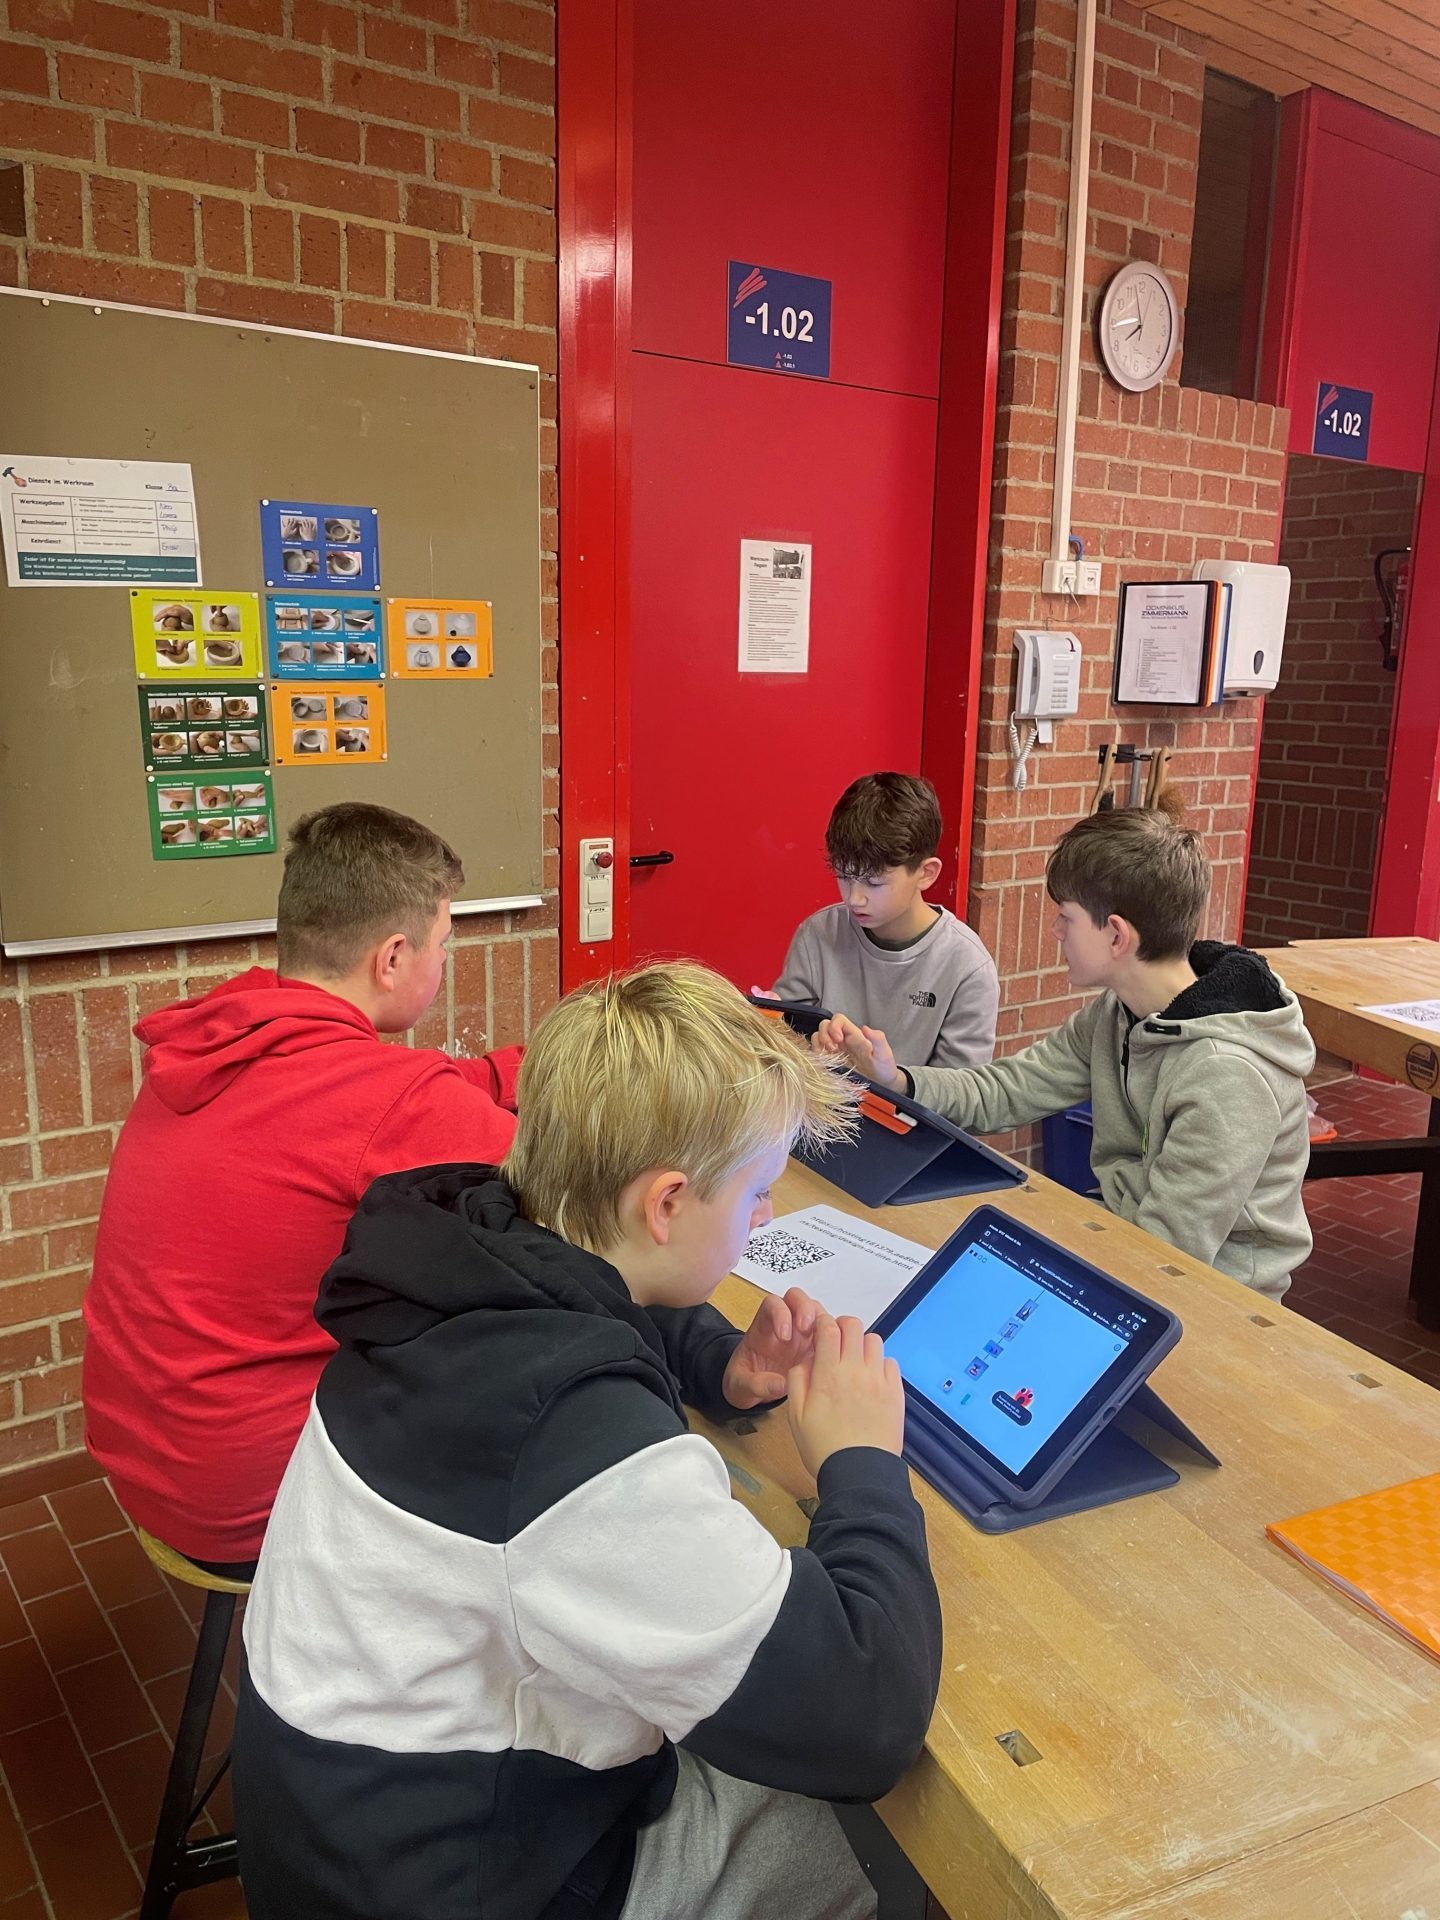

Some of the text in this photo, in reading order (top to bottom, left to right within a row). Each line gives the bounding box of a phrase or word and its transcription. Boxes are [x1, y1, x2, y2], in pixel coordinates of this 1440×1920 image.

[1127, 286, 1134, 299] 11
[1138, 280, 1147, 294] 12
[1116, 298, 1125, 311] 10
[1158, 304, 1166, 318] 2
[745, 302, 814, 343] -1.02
[1160, 325, 1168, 338] 3
[1113, 339, 1120, 353] 8
[1121, 354, 1128, 368] 7
[1133, 359, 1140, 374] 6
[1145, 356, 1153, 369] 5
[1324, 409, 1362, 437] -1.02
[908, 993, 929, 1002] NORTH
[911, 999, 928, 1007] FACE
